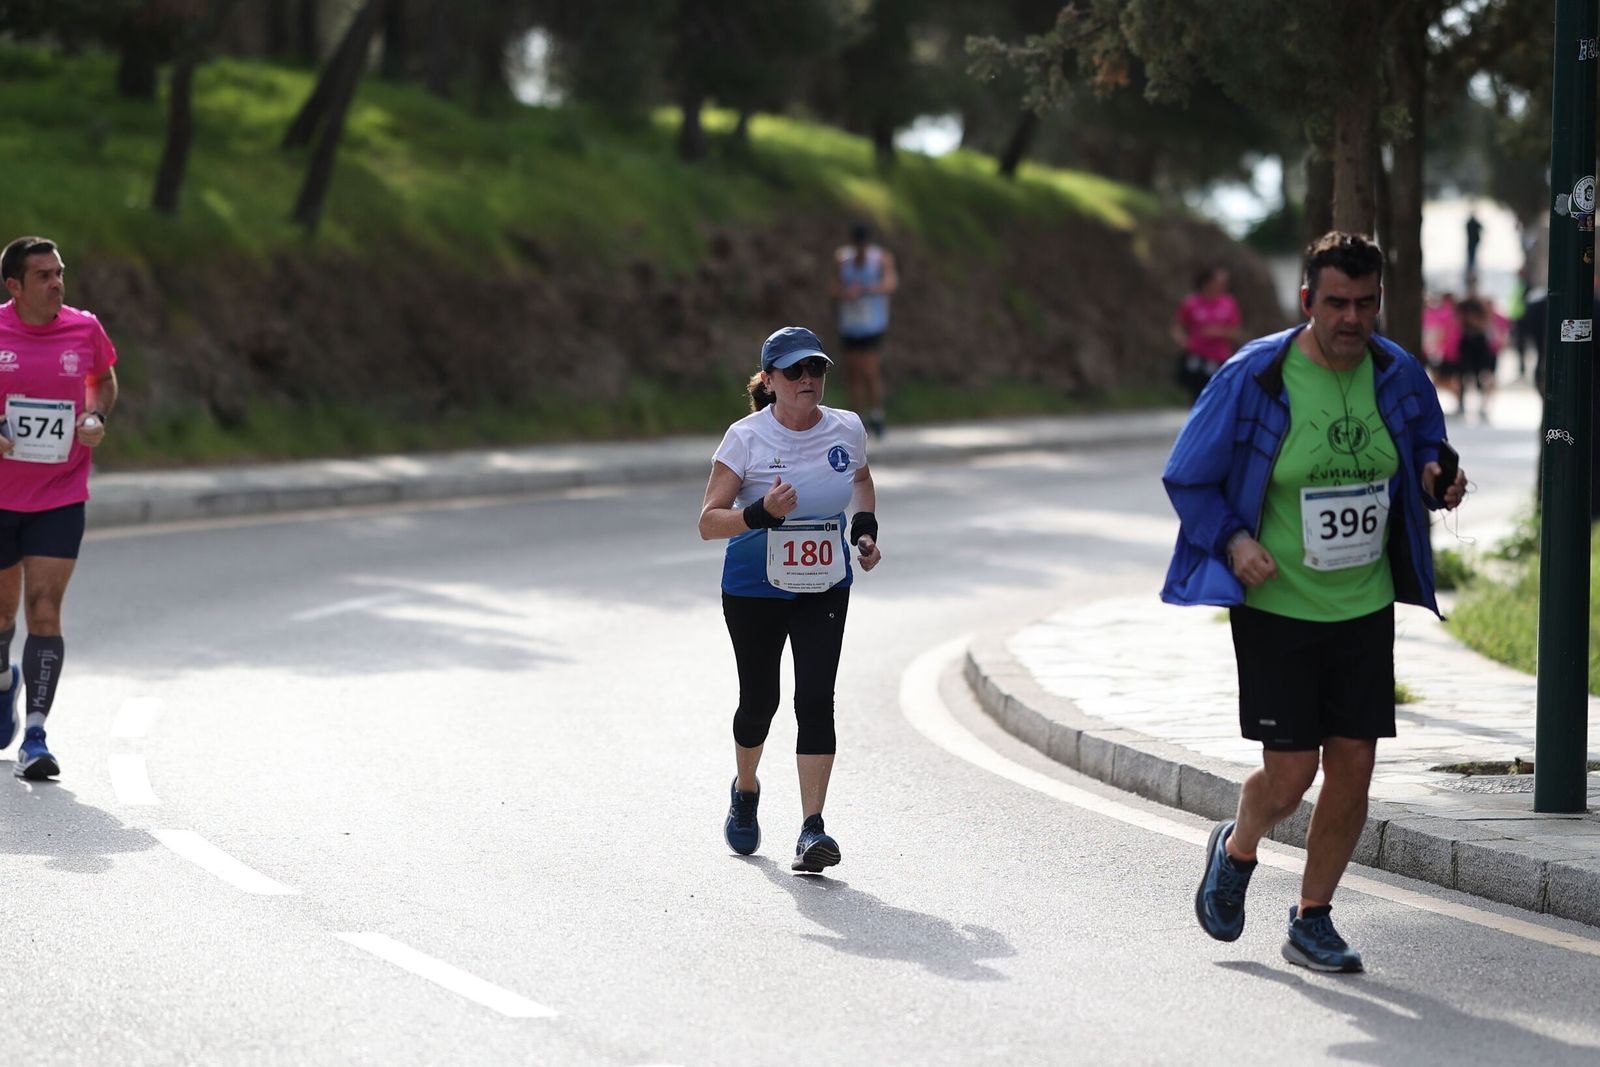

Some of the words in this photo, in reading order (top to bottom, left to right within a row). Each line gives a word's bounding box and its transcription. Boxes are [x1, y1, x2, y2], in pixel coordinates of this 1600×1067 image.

[17, 416, 65, 440] 574
[1306, 463, 1382, 482] Running
[1320, 505, 1378, 540] 396
[783, 540, 833, 567] 180
